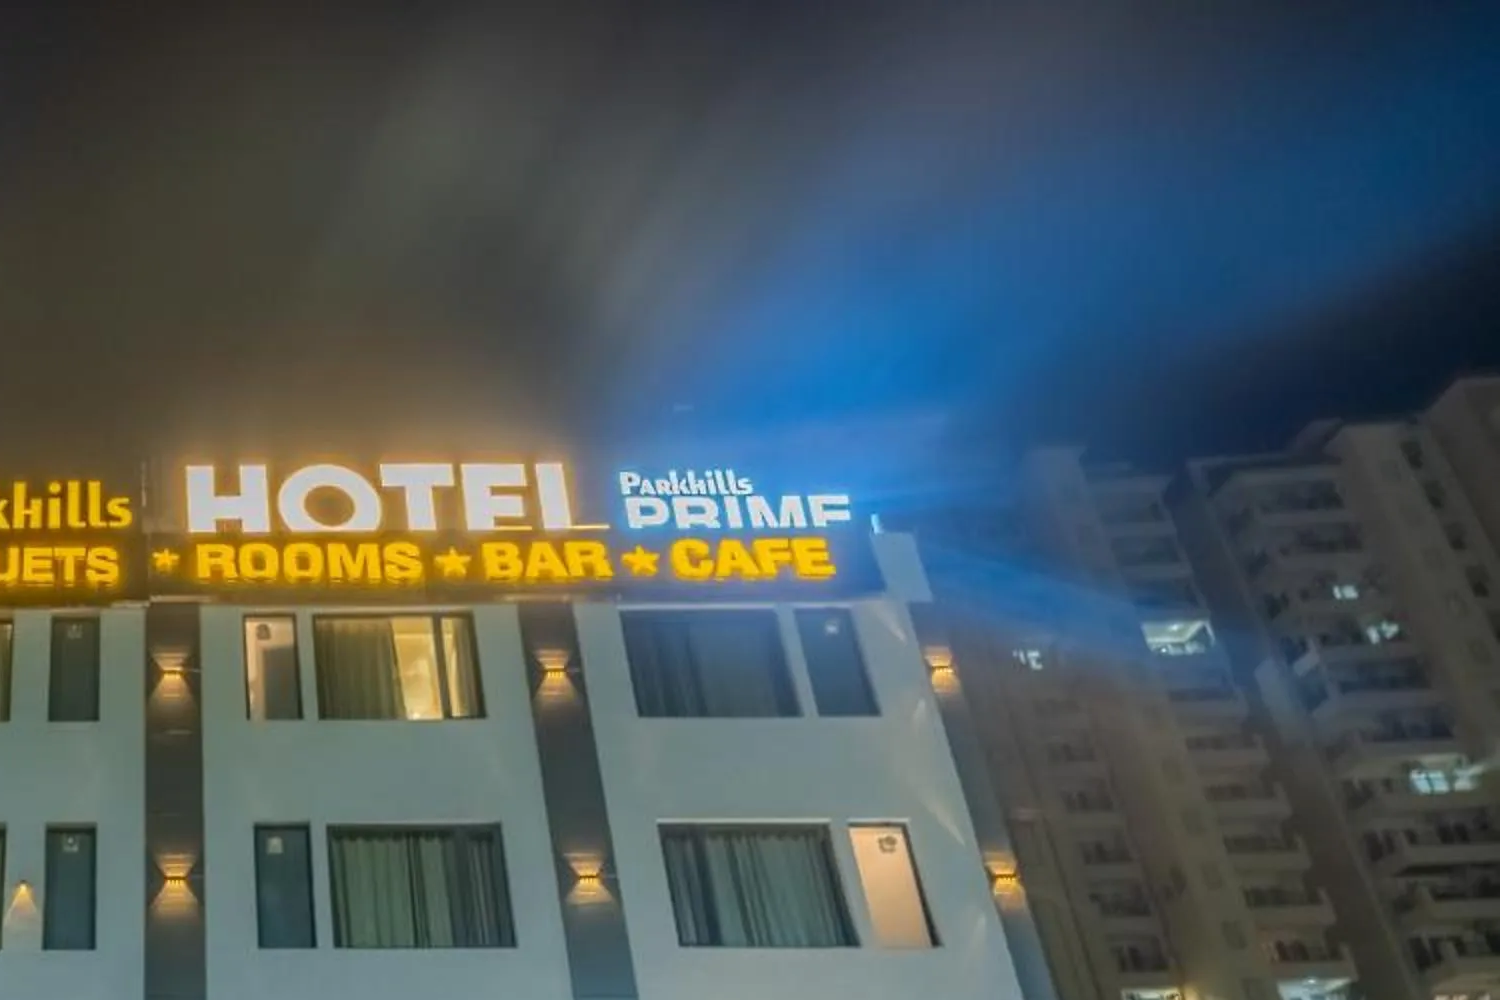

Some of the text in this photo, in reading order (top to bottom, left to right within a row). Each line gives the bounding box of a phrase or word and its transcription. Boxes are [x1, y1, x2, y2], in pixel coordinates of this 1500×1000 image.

[186, 463, 610, 533] HOTEL
[625, 494, 852, 530] PRIME
[196, 537, 837, 583] ROOMS BAR CAFE
